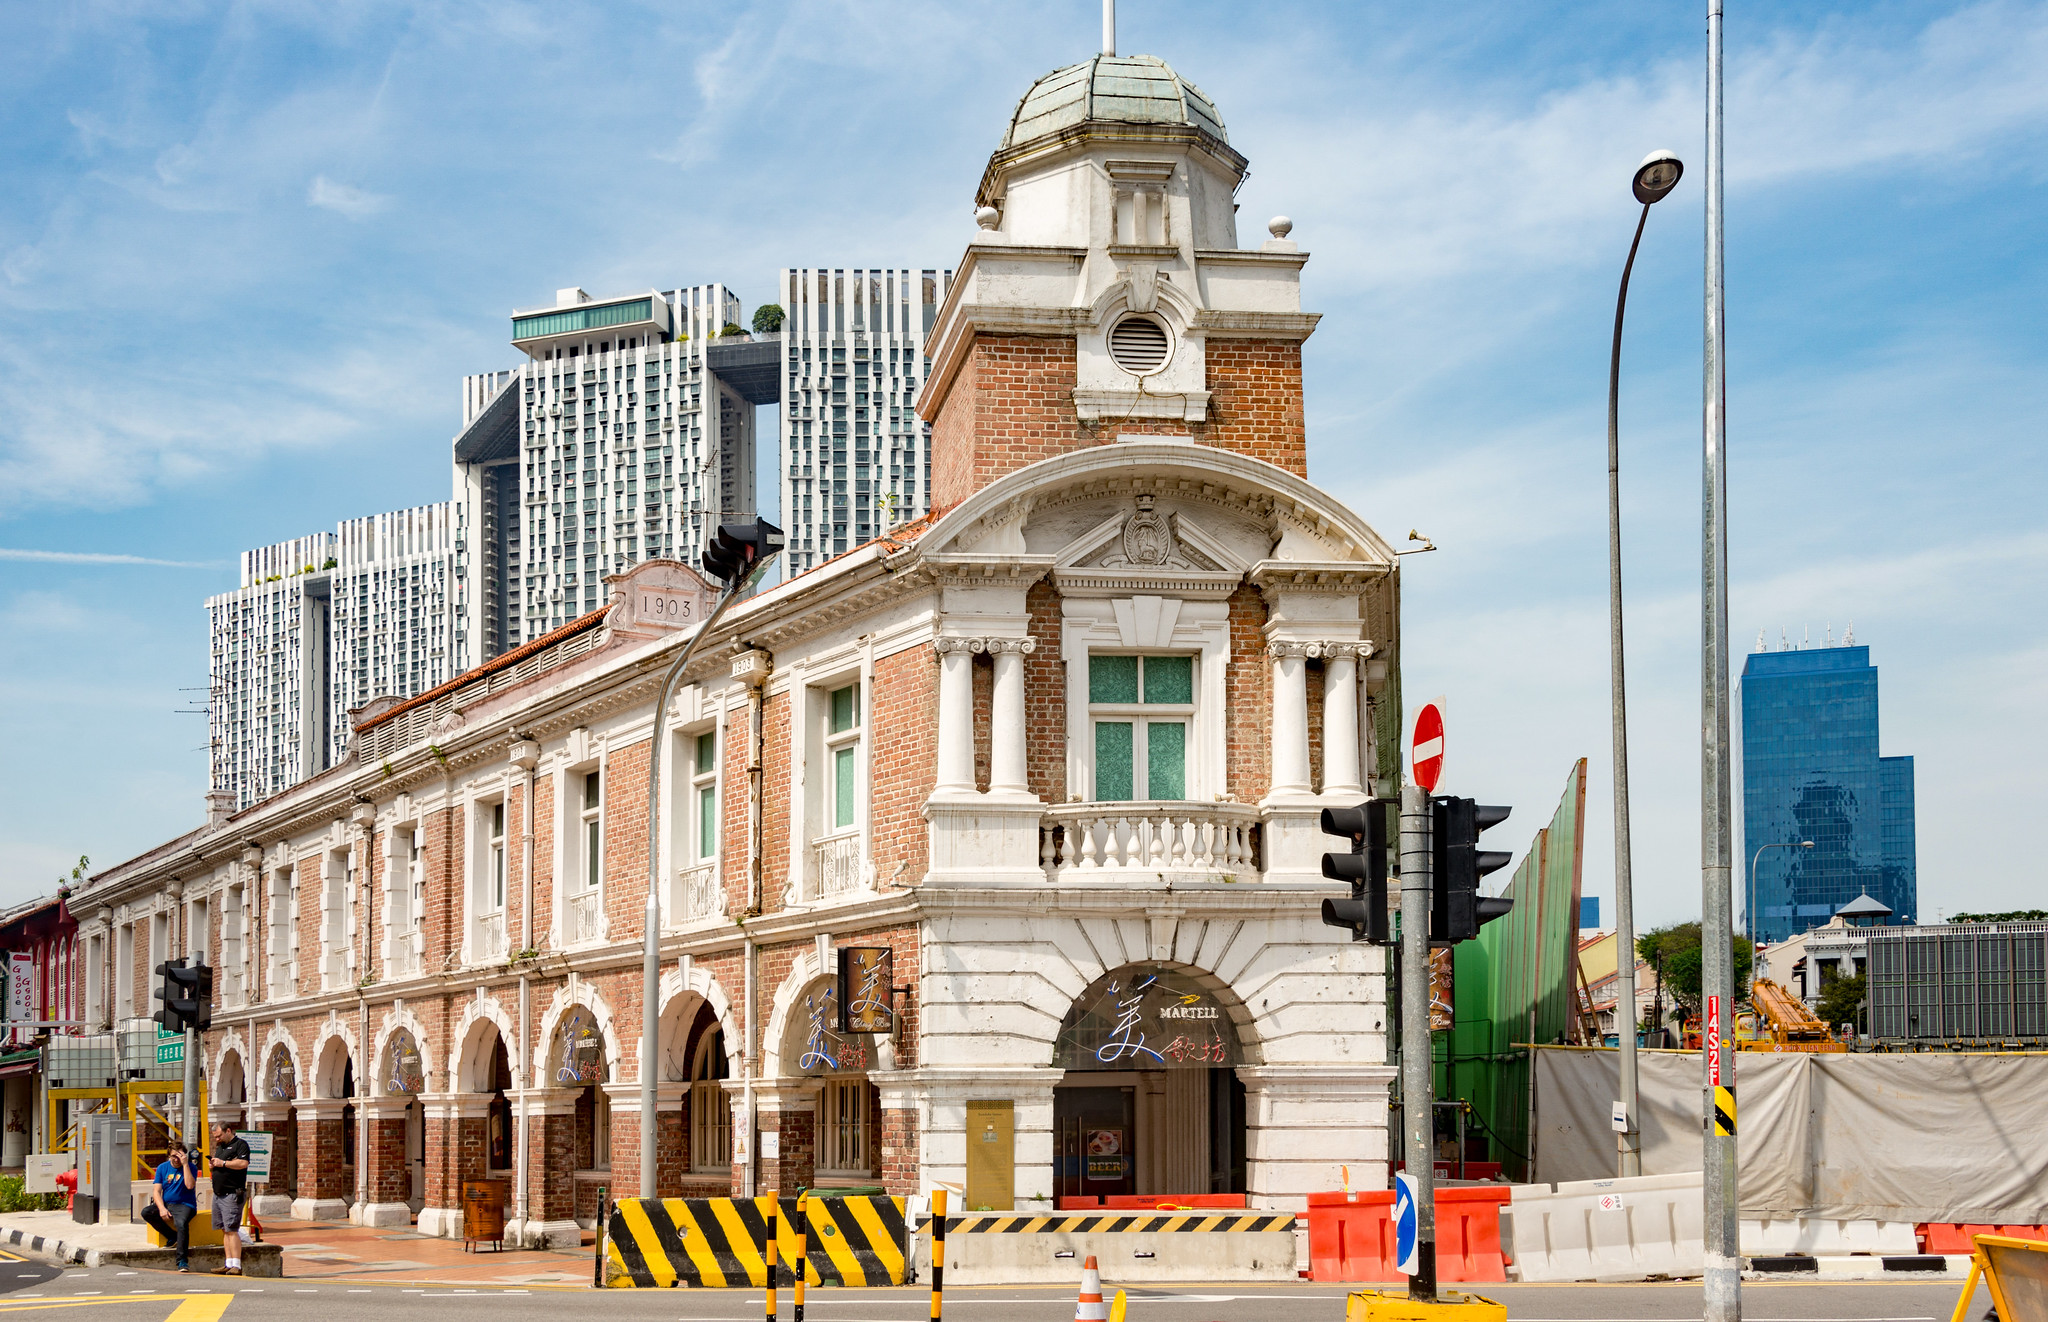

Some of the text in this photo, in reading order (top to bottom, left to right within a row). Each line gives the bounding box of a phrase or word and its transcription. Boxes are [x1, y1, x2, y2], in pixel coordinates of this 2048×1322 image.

[644, 596, 691, 618] 1903
[1159, 1006, 1219, 1020] MARTELL
[1708, 996, 1719, 1086] 14S2F
[1088, 1162, 1121, 1172] BEER
